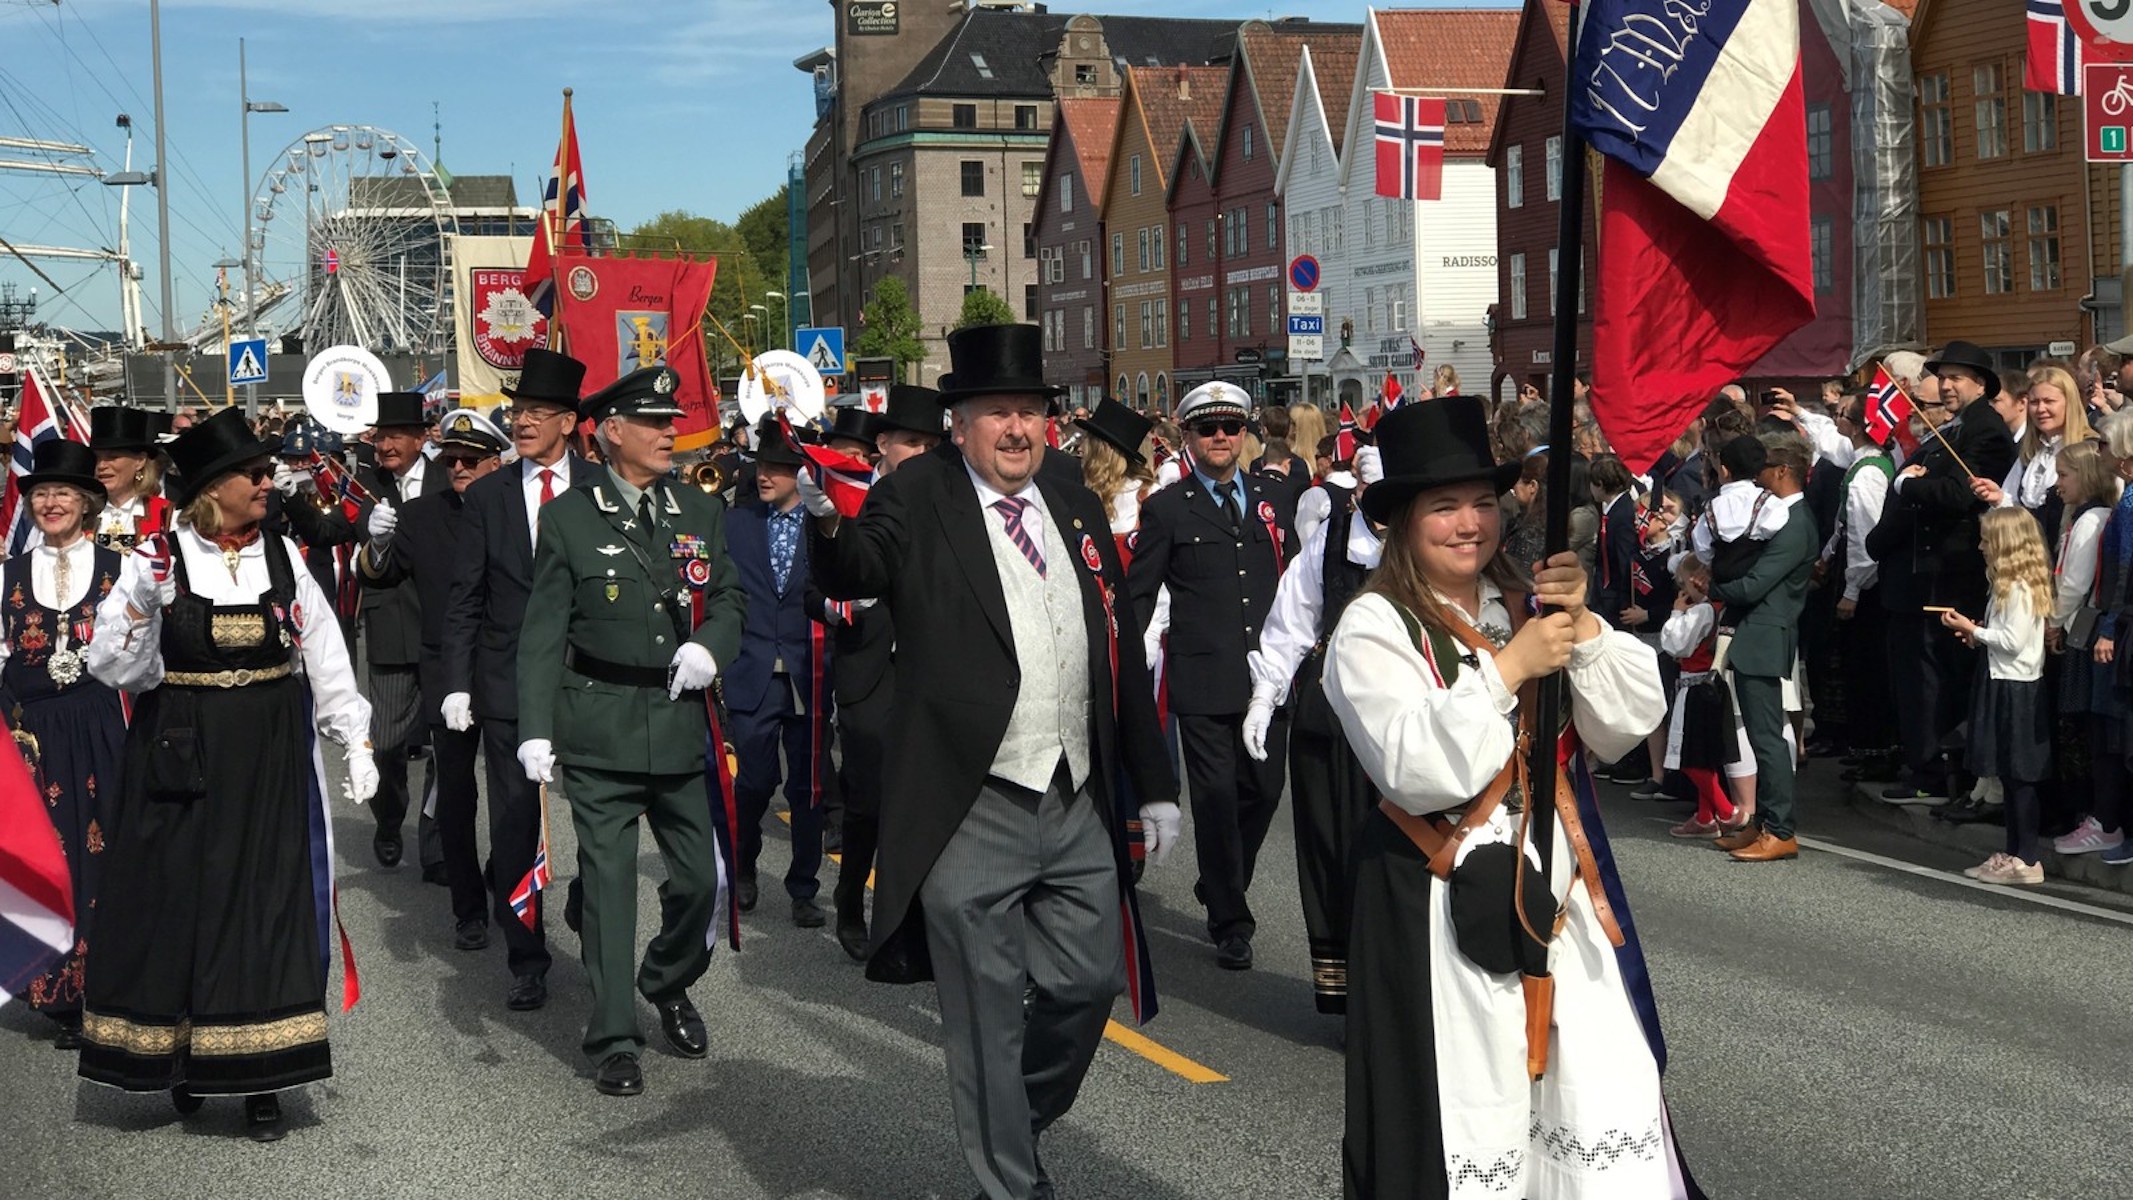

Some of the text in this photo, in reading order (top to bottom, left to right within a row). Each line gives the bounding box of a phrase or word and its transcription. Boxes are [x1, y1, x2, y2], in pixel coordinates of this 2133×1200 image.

[850, 5, 881, 17] Clarion
[858, 17, 896, 25] Collection
[1586, 60, 1660, 145] 17
[2110, 130, 2118, 148] 1
[478, 274, 526, 285] BERG
[629, 285, 663, 307] Bergen
[1292, 318, 1320, 330] Taxi
[477, 333, 546, 366] BRANNVEN
[826, 377, 834, 387] A
